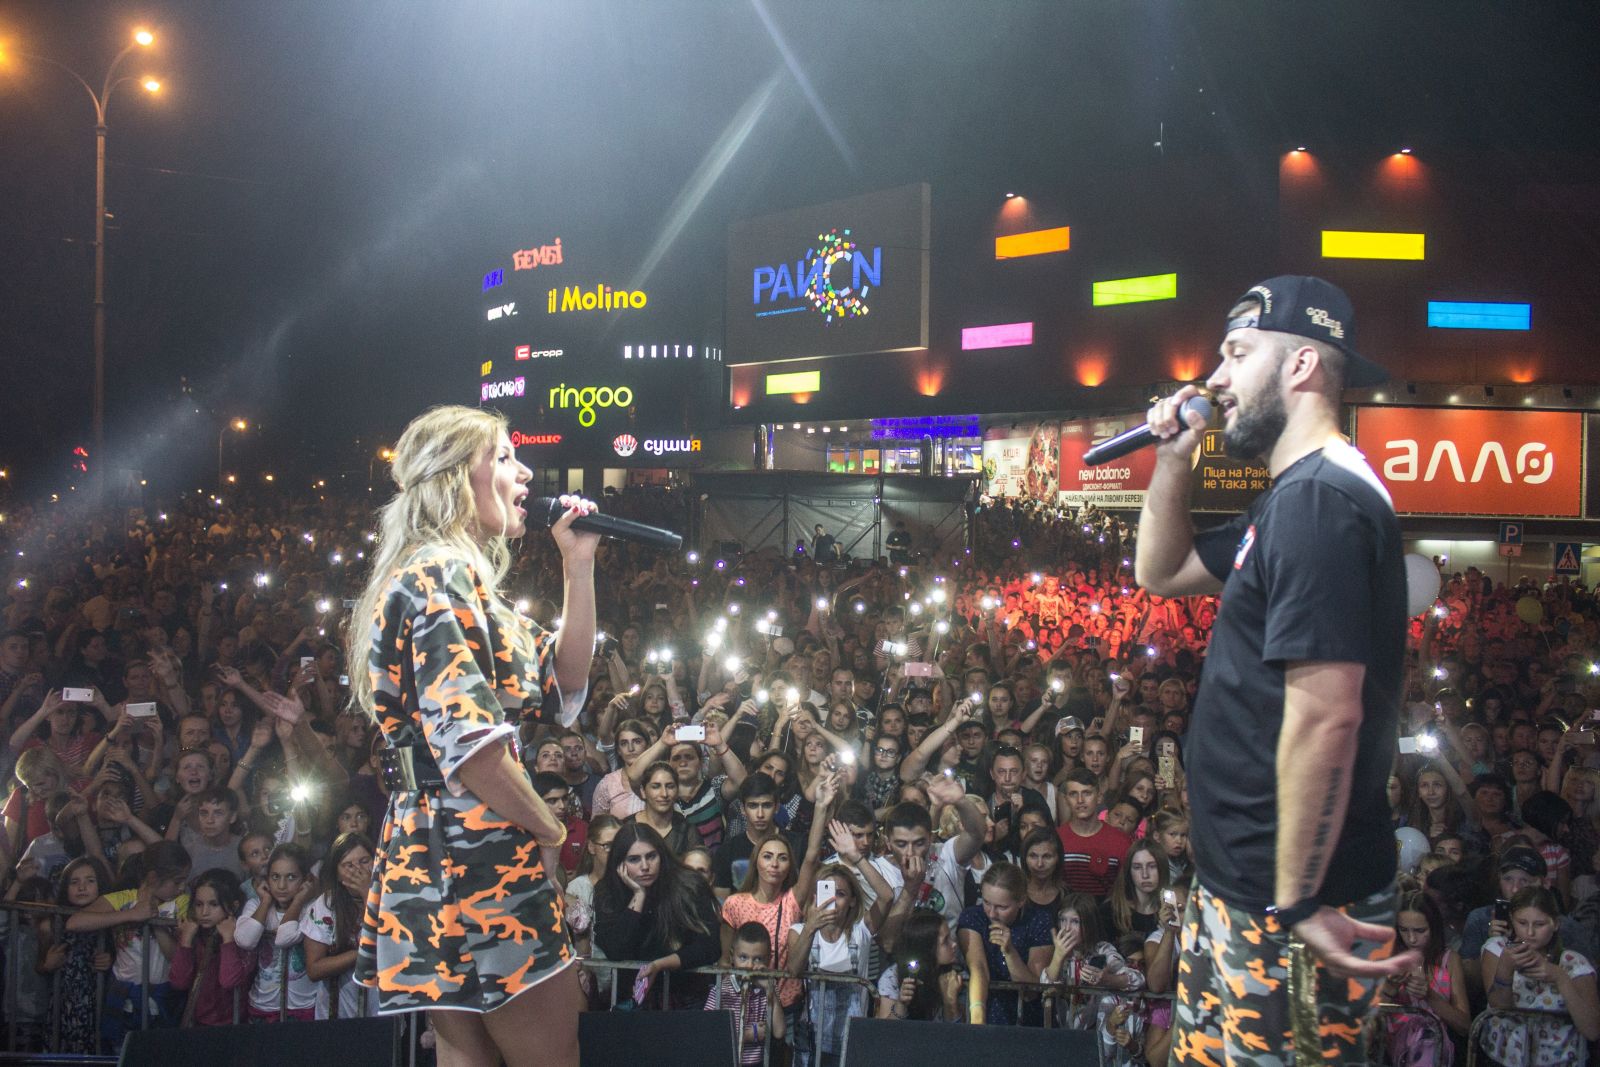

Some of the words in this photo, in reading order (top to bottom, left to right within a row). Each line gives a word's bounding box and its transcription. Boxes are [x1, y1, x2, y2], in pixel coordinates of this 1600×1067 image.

[561, 284, 647, 312] Molino
[549, 383, 633, 427] ringoo
[1079, 469, 1095, 480] new
[1096, 466, 1130, 480] balance
[1203, 467, 1226, 479] Піца
[1228, 469, 1242, 477] на
[1203, 480, 1217, 489] не
[1219, 480, 1247, 489] така
[1250, 480, 1265, 489] як
[1505, 525, 1519, 542] P
